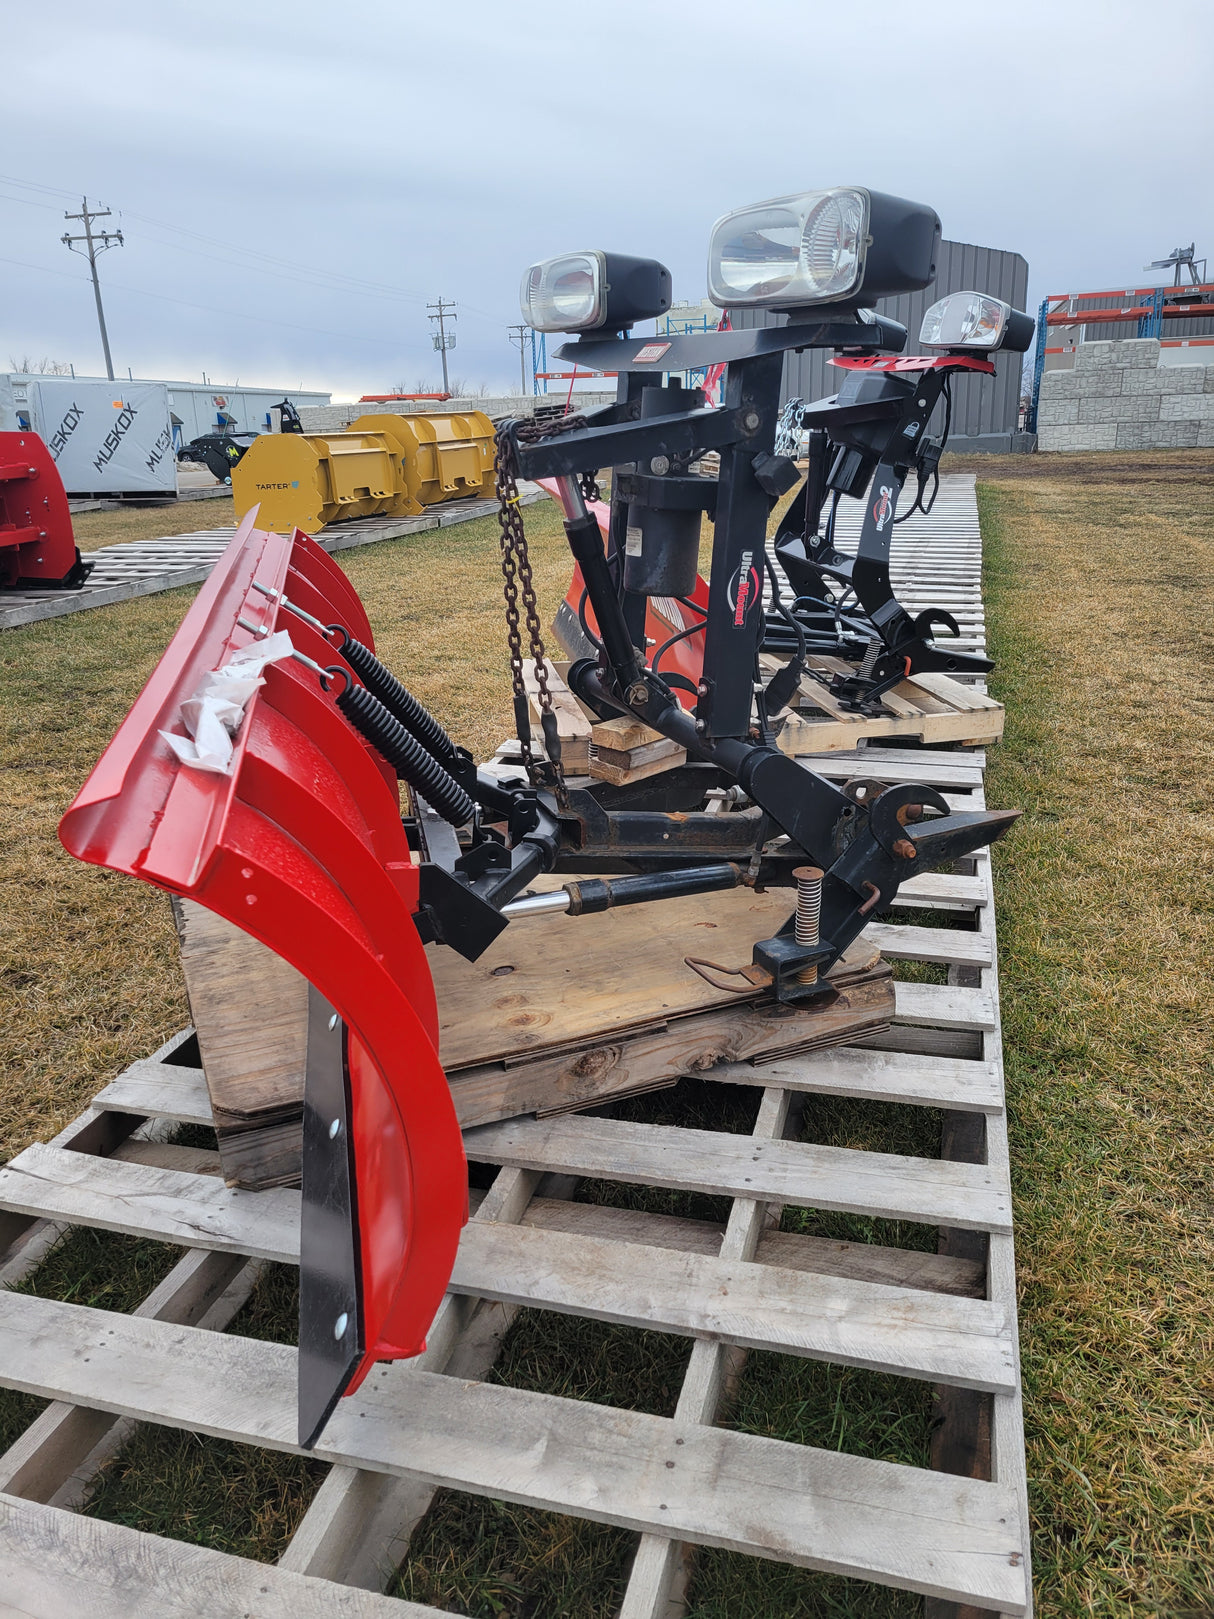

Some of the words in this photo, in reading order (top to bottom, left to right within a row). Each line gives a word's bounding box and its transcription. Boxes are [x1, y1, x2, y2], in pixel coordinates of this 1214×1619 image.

[48, 402, 84, 462] USKOX
[93, 402, 138, 473] MUSKOX
[734, 551, 753, 625] UltraMount
